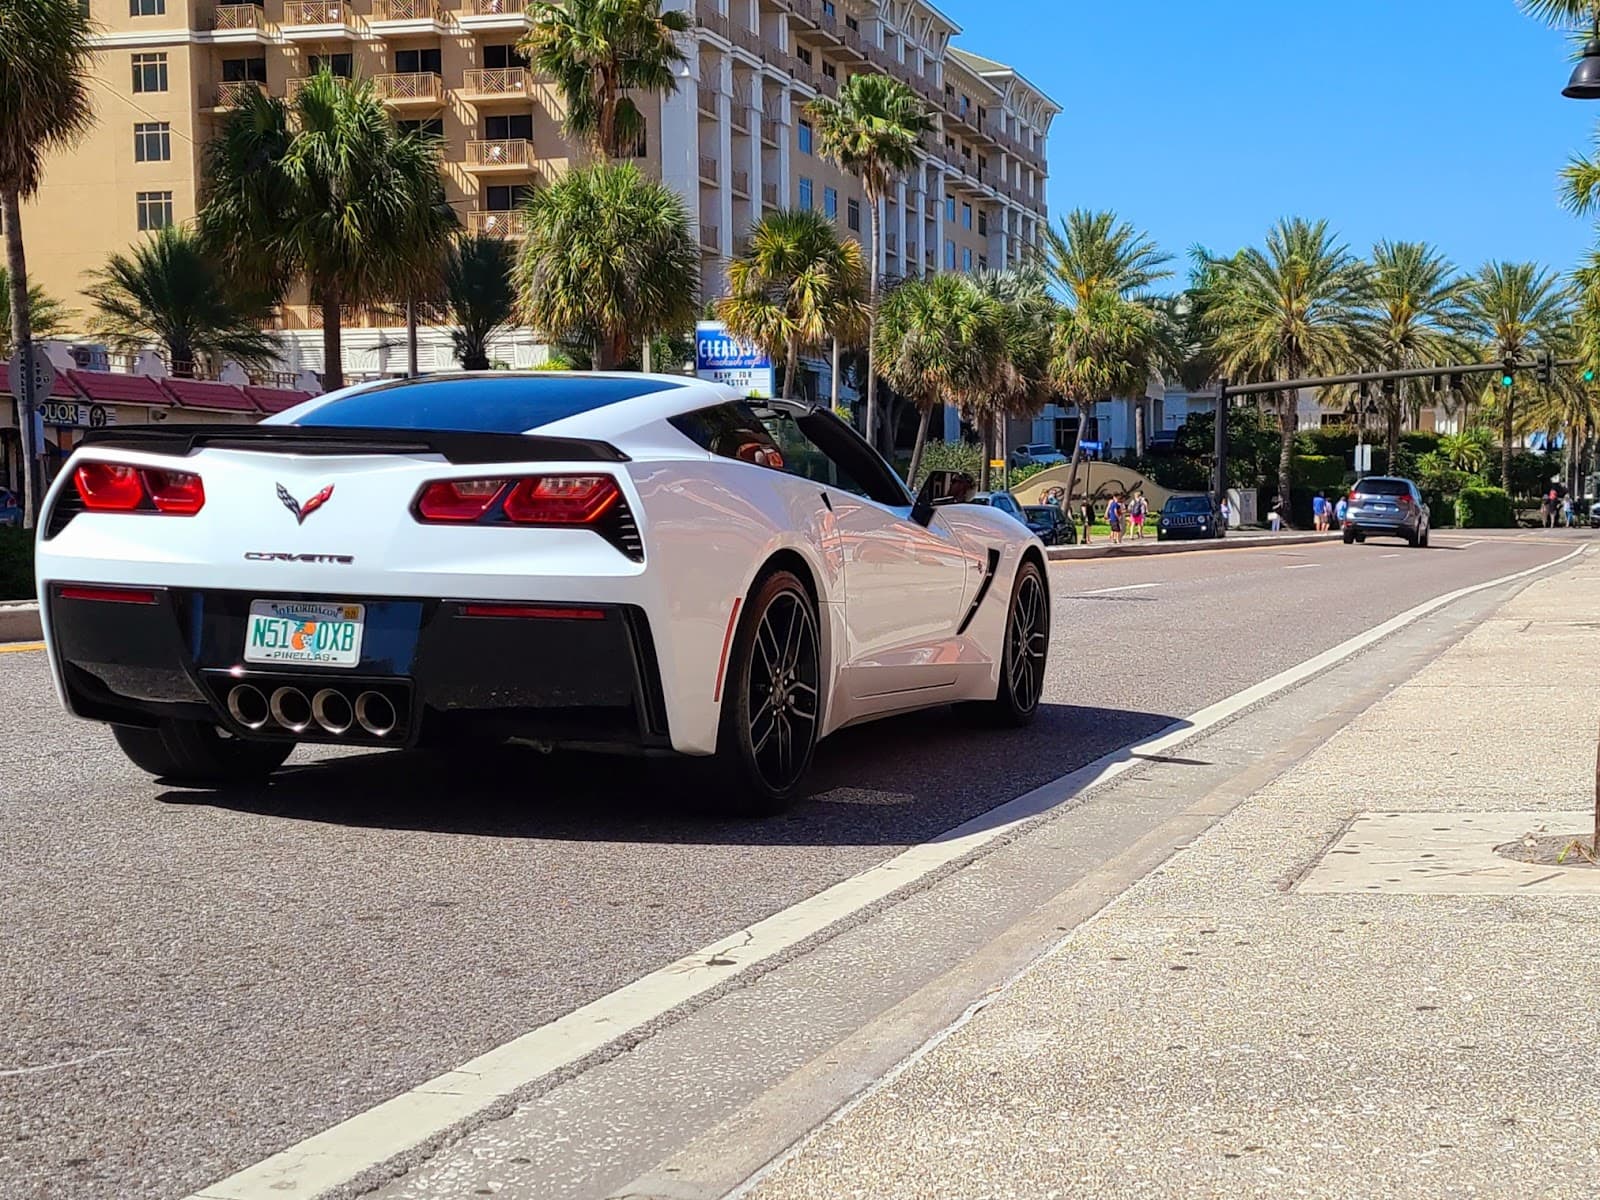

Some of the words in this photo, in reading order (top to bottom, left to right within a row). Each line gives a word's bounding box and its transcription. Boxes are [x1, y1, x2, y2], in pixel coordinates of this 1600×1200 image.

[40, 403, 78, 421] QUOR
[244, 552, 354, 565] CORVETTE
[252, 618, 289, 648] N51
[273, 651, 330, 661] PINELLAS
